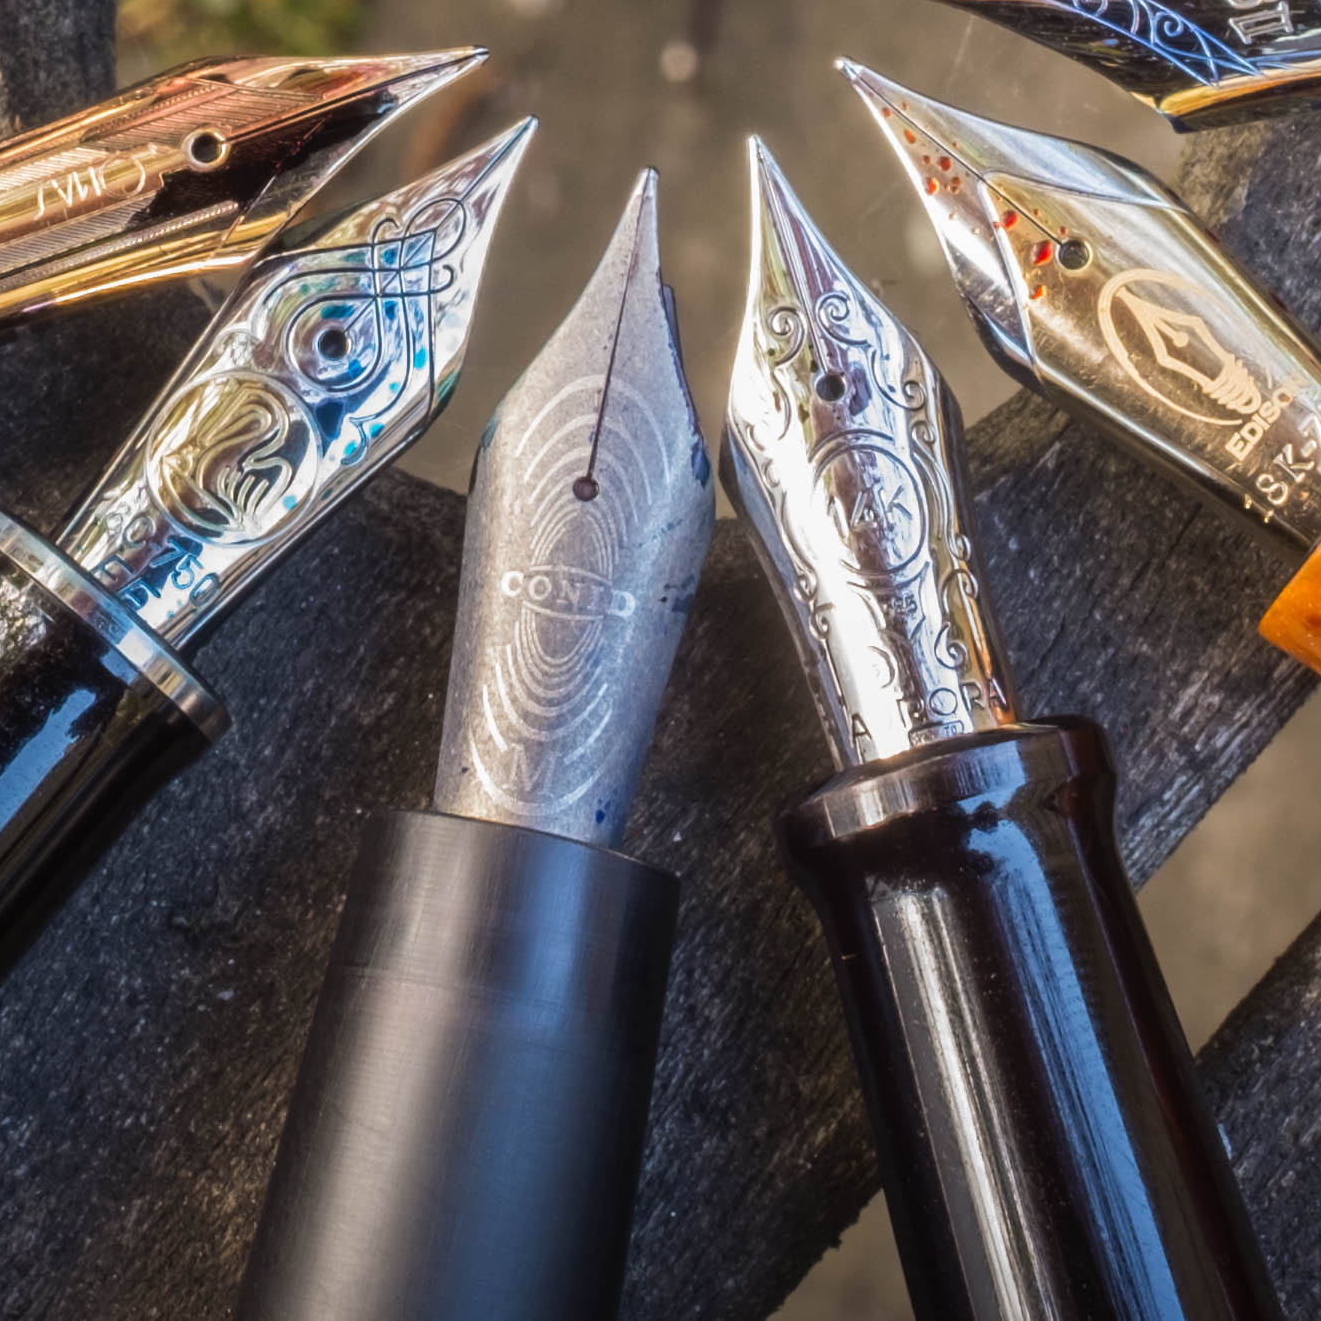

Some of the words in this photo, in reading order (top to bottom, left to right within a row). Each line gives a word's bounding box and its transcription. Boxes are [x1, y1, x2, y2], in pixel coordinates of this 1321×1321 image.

[1224, 372, 1306, 462] EDISON
[501, 570, 636, 618] CONID
[846, 674, 1008, 744] ARORA
